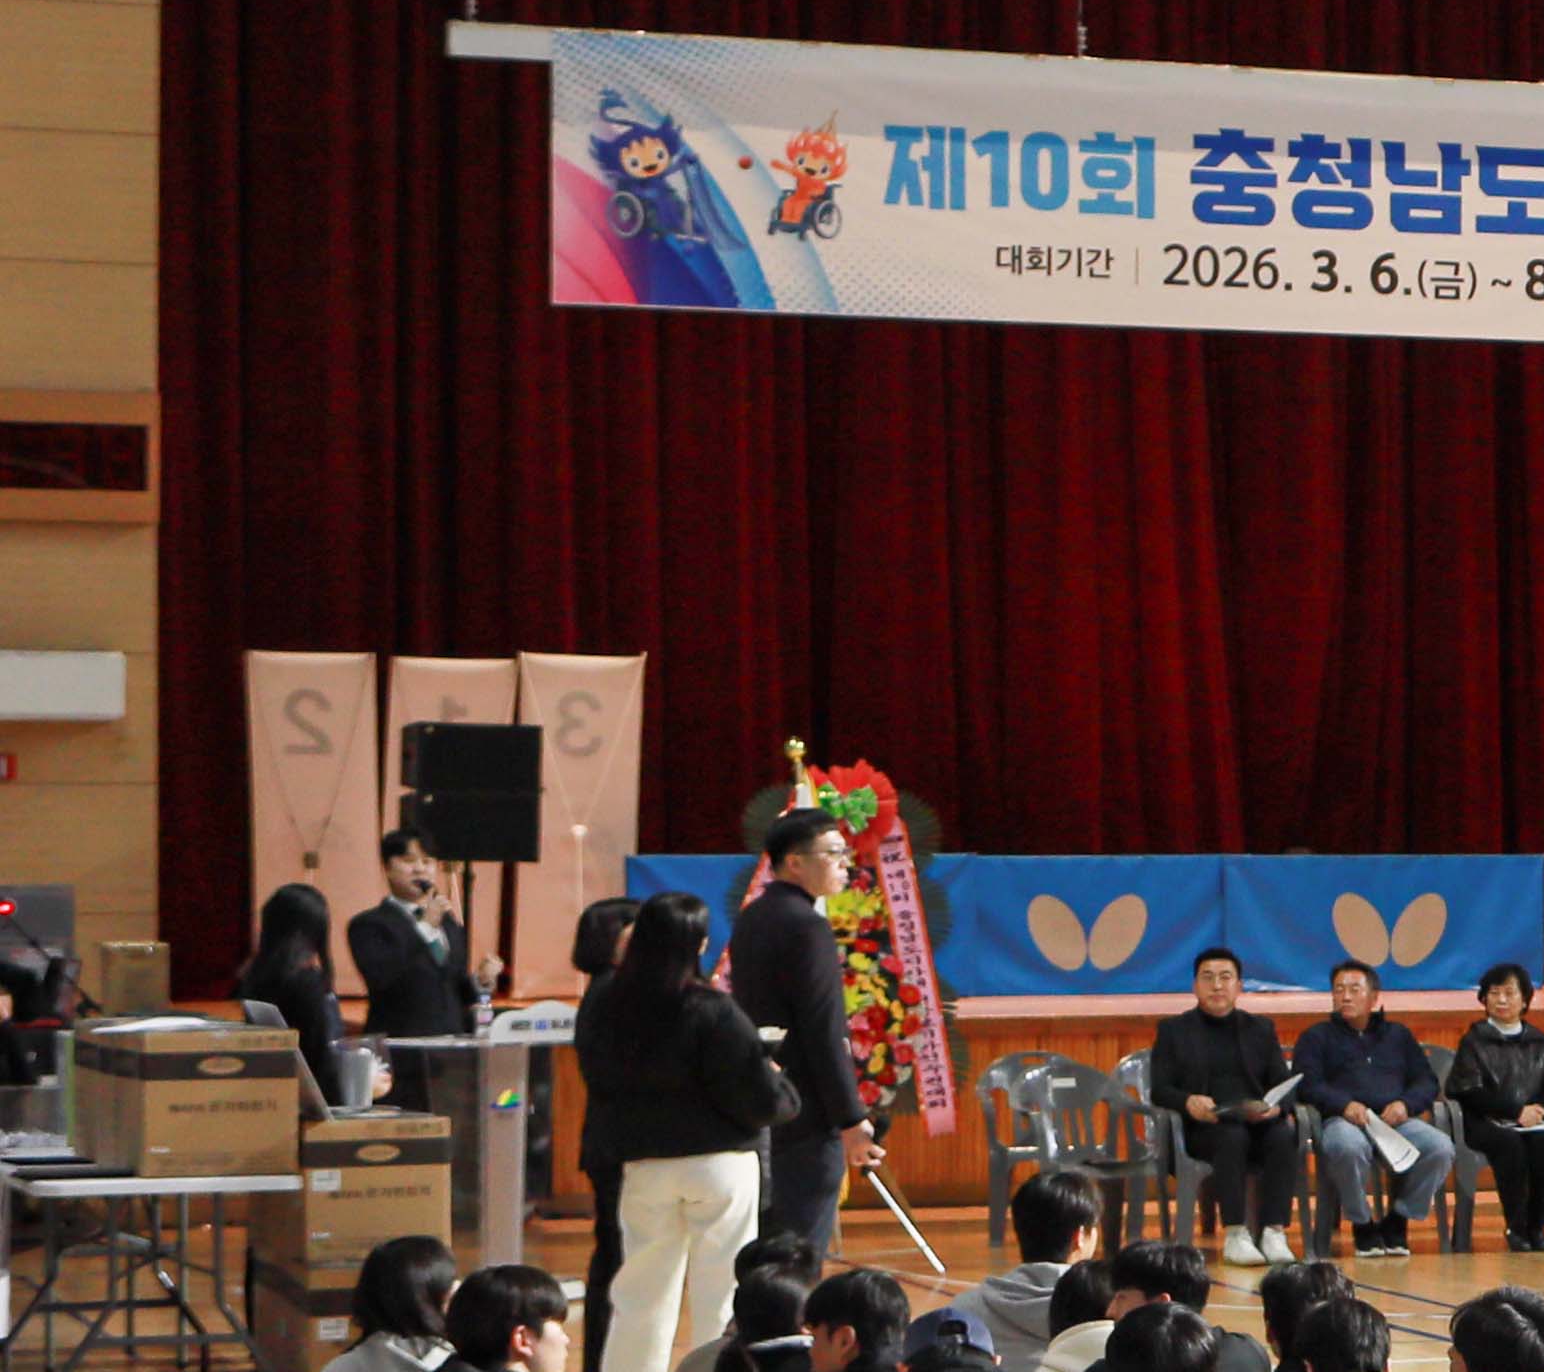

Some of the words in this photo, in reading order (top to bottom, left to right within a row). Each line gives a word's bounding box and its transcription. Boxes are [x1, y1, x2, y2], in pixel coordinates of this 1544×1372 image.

[883, 124, 1156, 220] 제10회
[996, 245, 1115, 280] 대회기간
[1162, 243, 1294, 292] 2026.
[1310, 249, 1354, 294] 3.
[1369, 252, 1478, 301] 6.(금)
